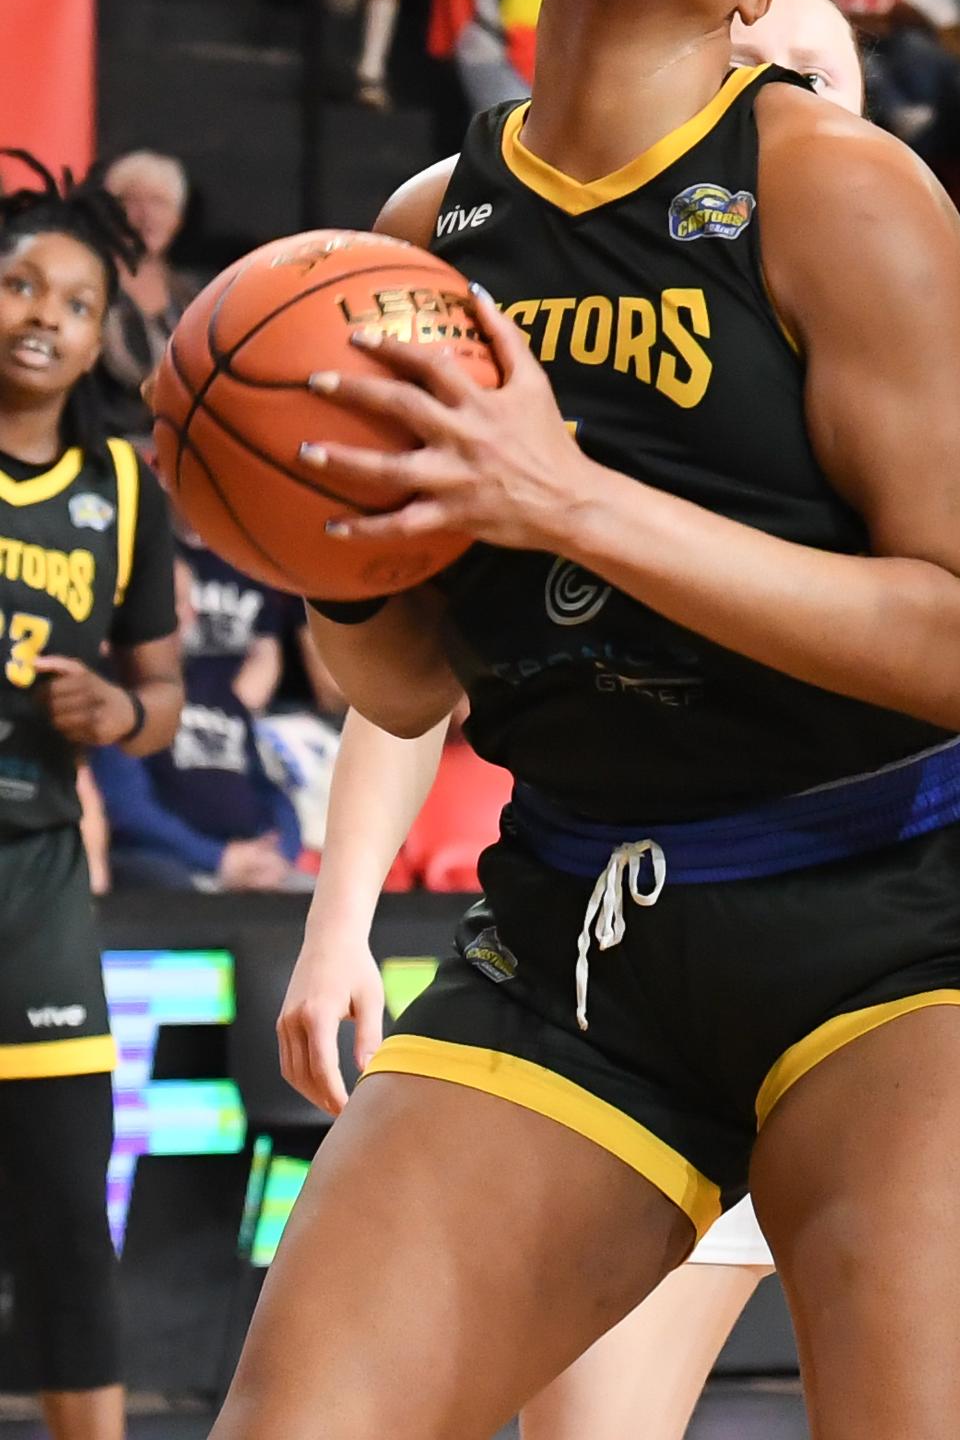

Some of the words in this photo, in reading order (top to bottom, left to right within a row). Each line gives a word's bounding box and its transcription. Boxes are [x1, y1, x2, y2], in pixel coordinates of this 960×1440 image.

[436, 202, 493, 237] vive
[677, 208, 744, 237] CASTORS
[496, 287, 713, 408] STORS
[0, 537, 95, 622] TORS
[0, 610, 52, 688] 3
